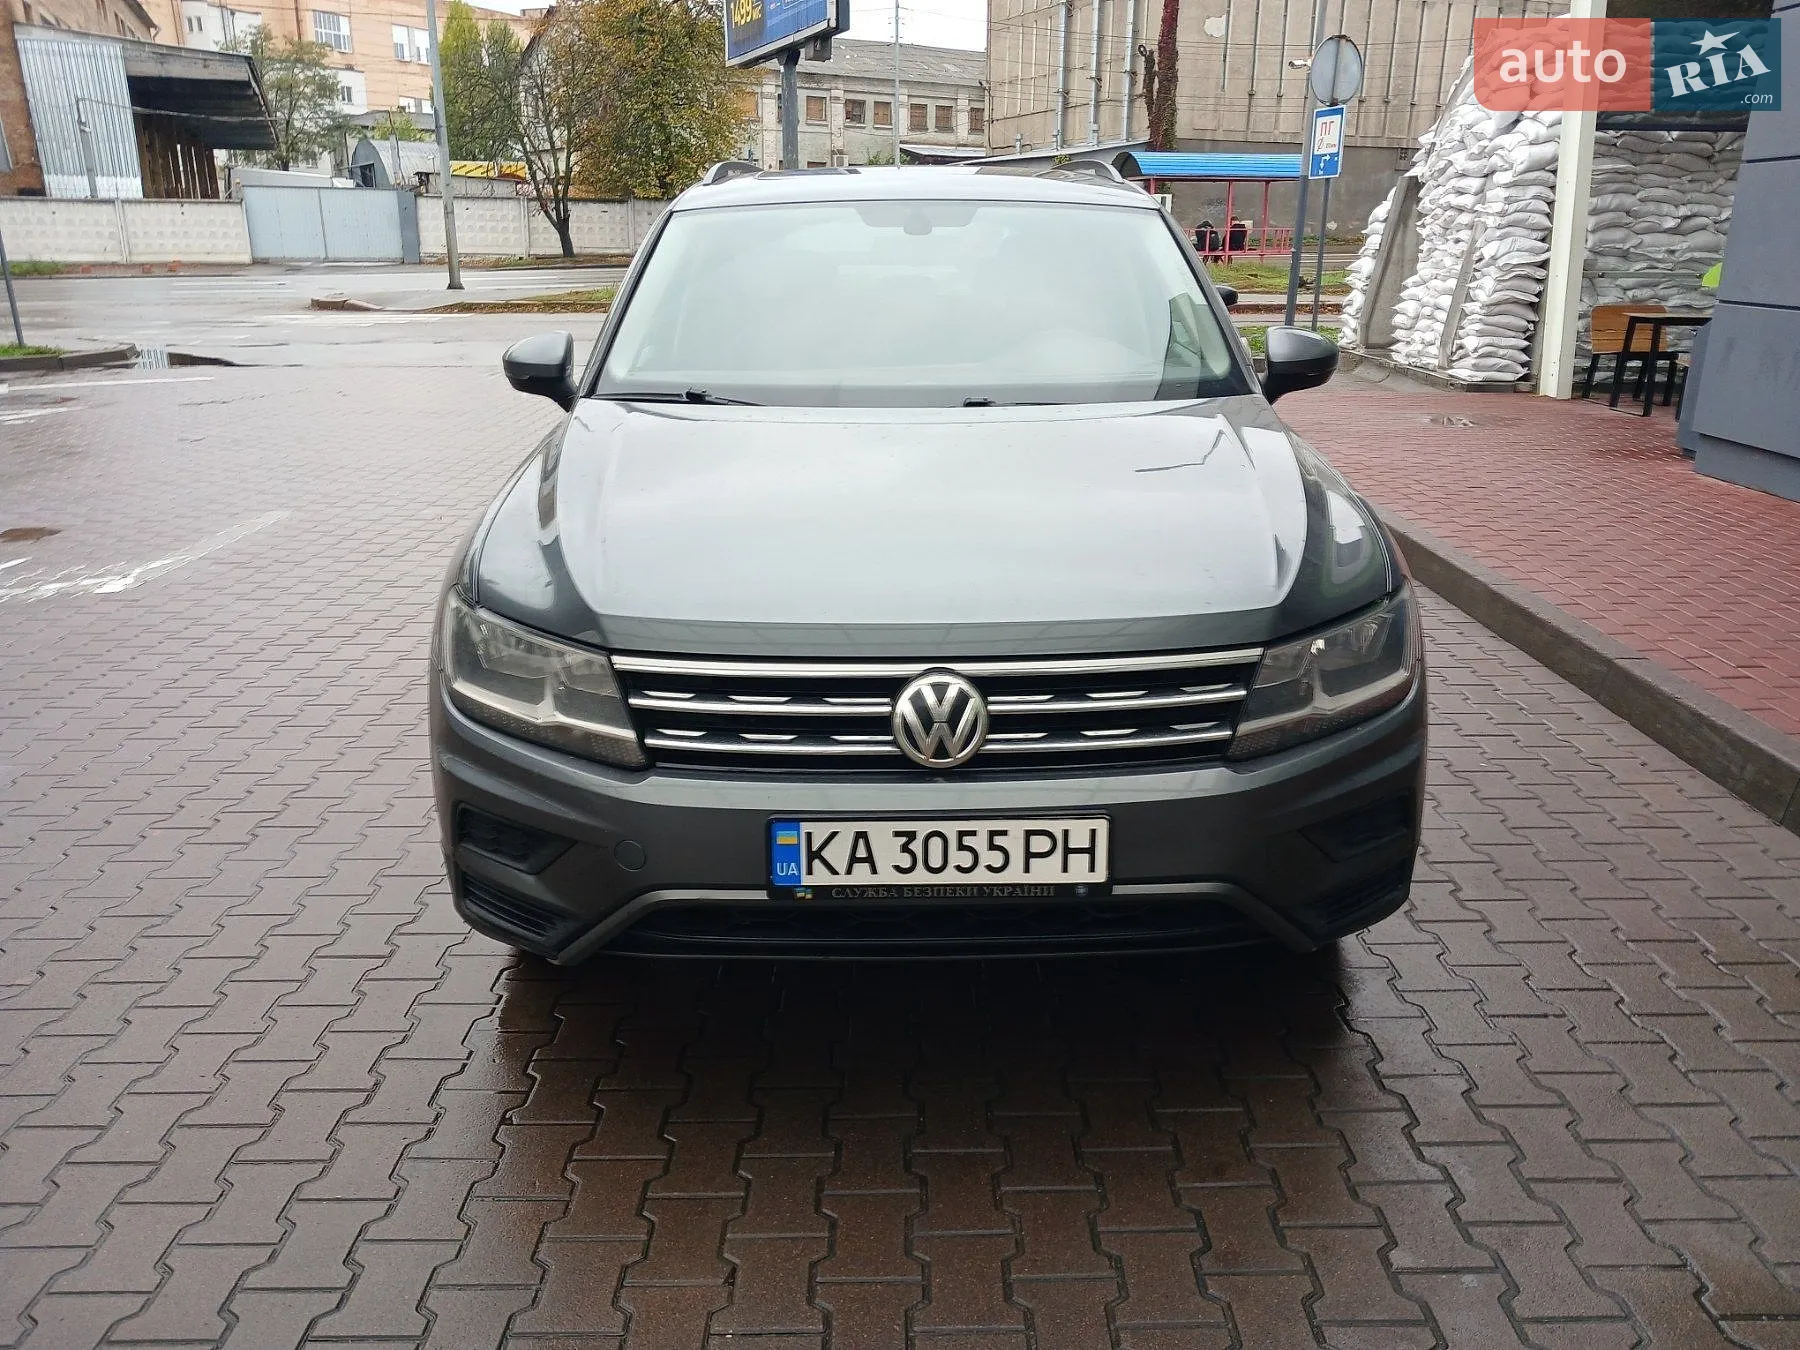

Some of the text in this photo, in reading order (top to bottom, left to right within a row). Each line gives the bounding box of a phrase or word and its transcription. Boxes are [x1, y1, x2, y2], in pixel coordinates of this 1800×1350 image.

[805, 828, 1097, 876] KA 3055 PH
[777, 862, 798, 876] UA
[832, 884, 1055, 899] СЛУЖБА БЕЗПЕКИ УКРАЇНИ
